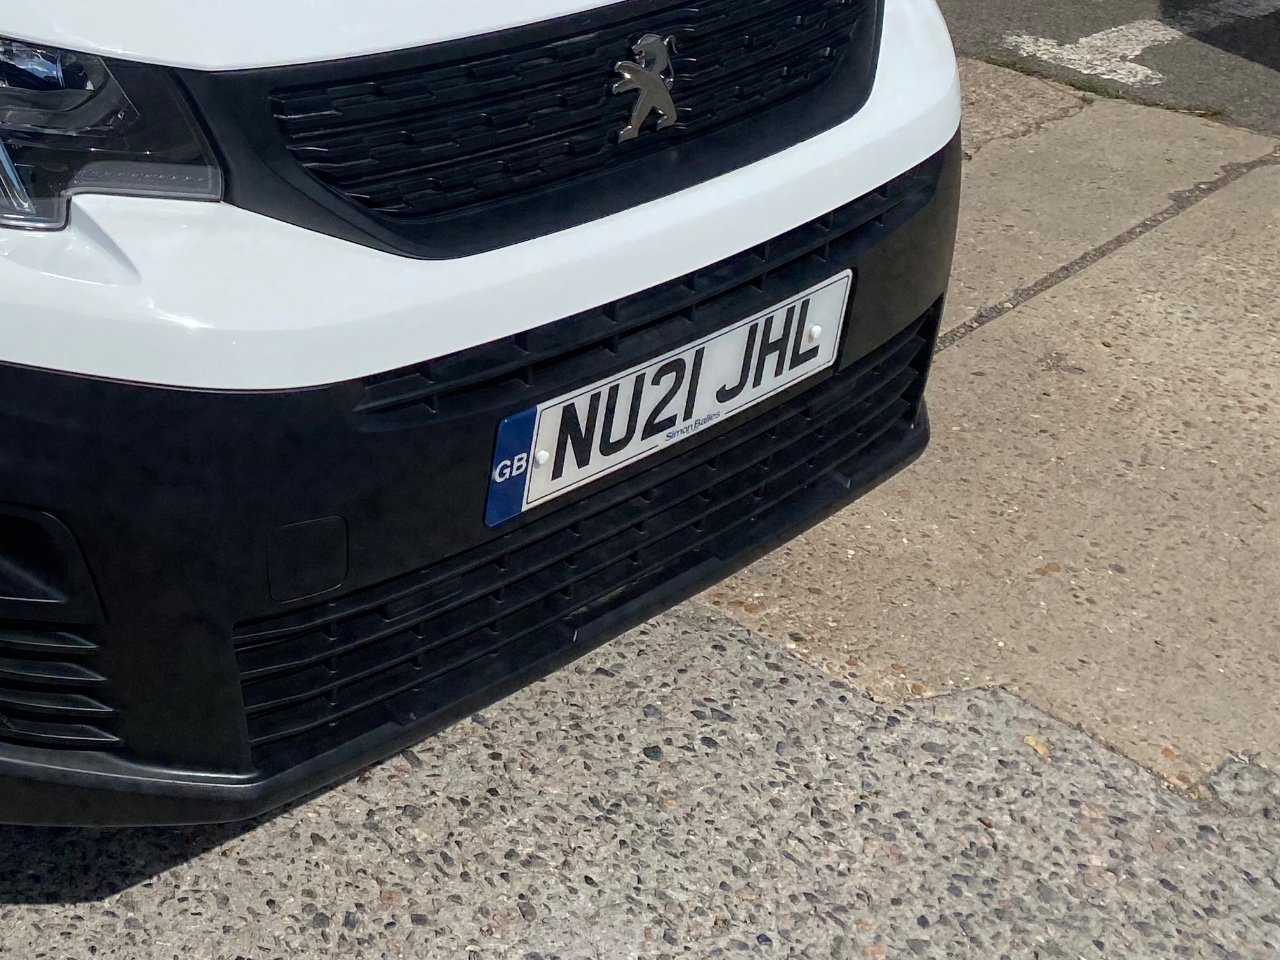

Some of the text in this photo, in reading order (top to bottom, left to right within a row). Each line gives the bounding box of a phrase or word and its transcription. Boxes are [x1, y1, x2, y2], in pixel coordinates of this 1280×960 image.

[551, 298, 820, 481] NU21 JHL
[665, 423, 694, 441] Simon
[493, 451, 528, 483] GB
